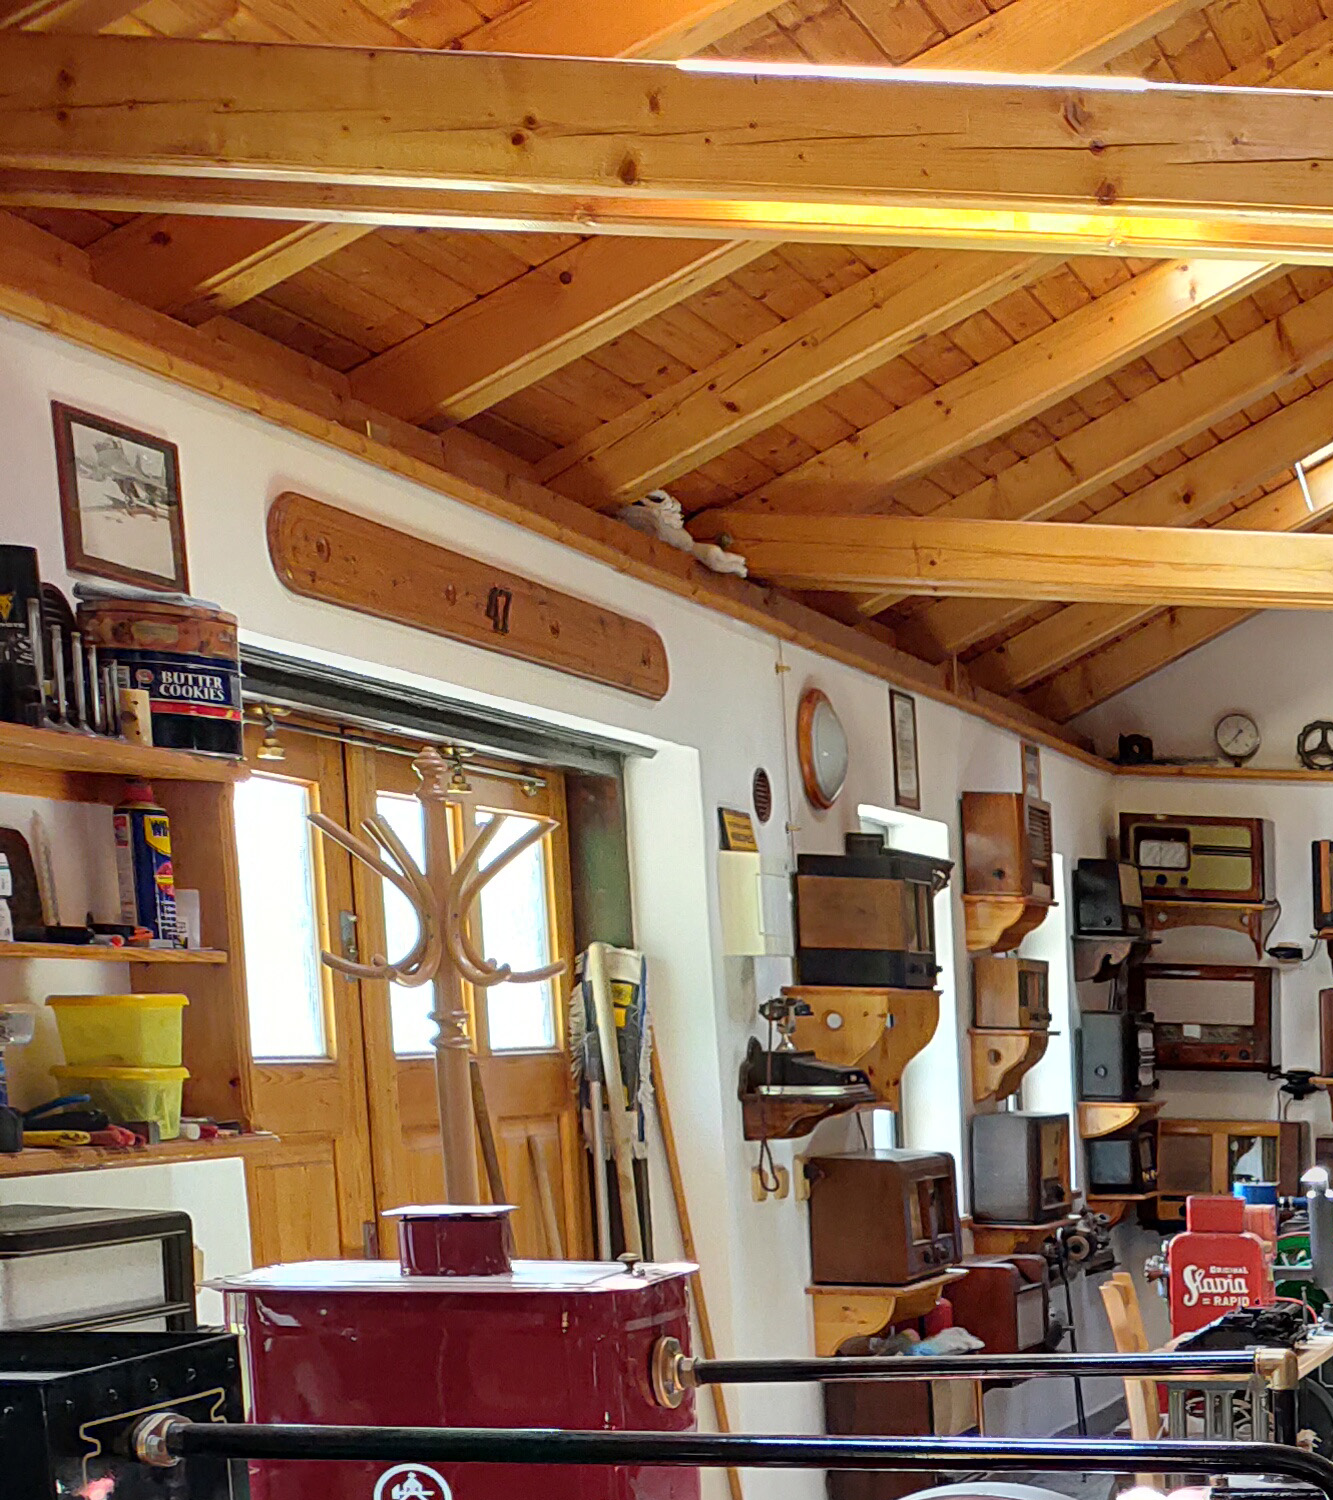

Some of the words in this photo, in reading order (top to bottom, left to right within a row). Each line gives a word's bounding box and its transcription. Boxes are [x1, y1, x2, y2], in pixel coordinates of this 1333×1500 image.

[161, 670, 223, 690] BUTTER
[159, 683, 226, 701] COOKIES
[1212, 1296, 1250, 1307] RAPID
